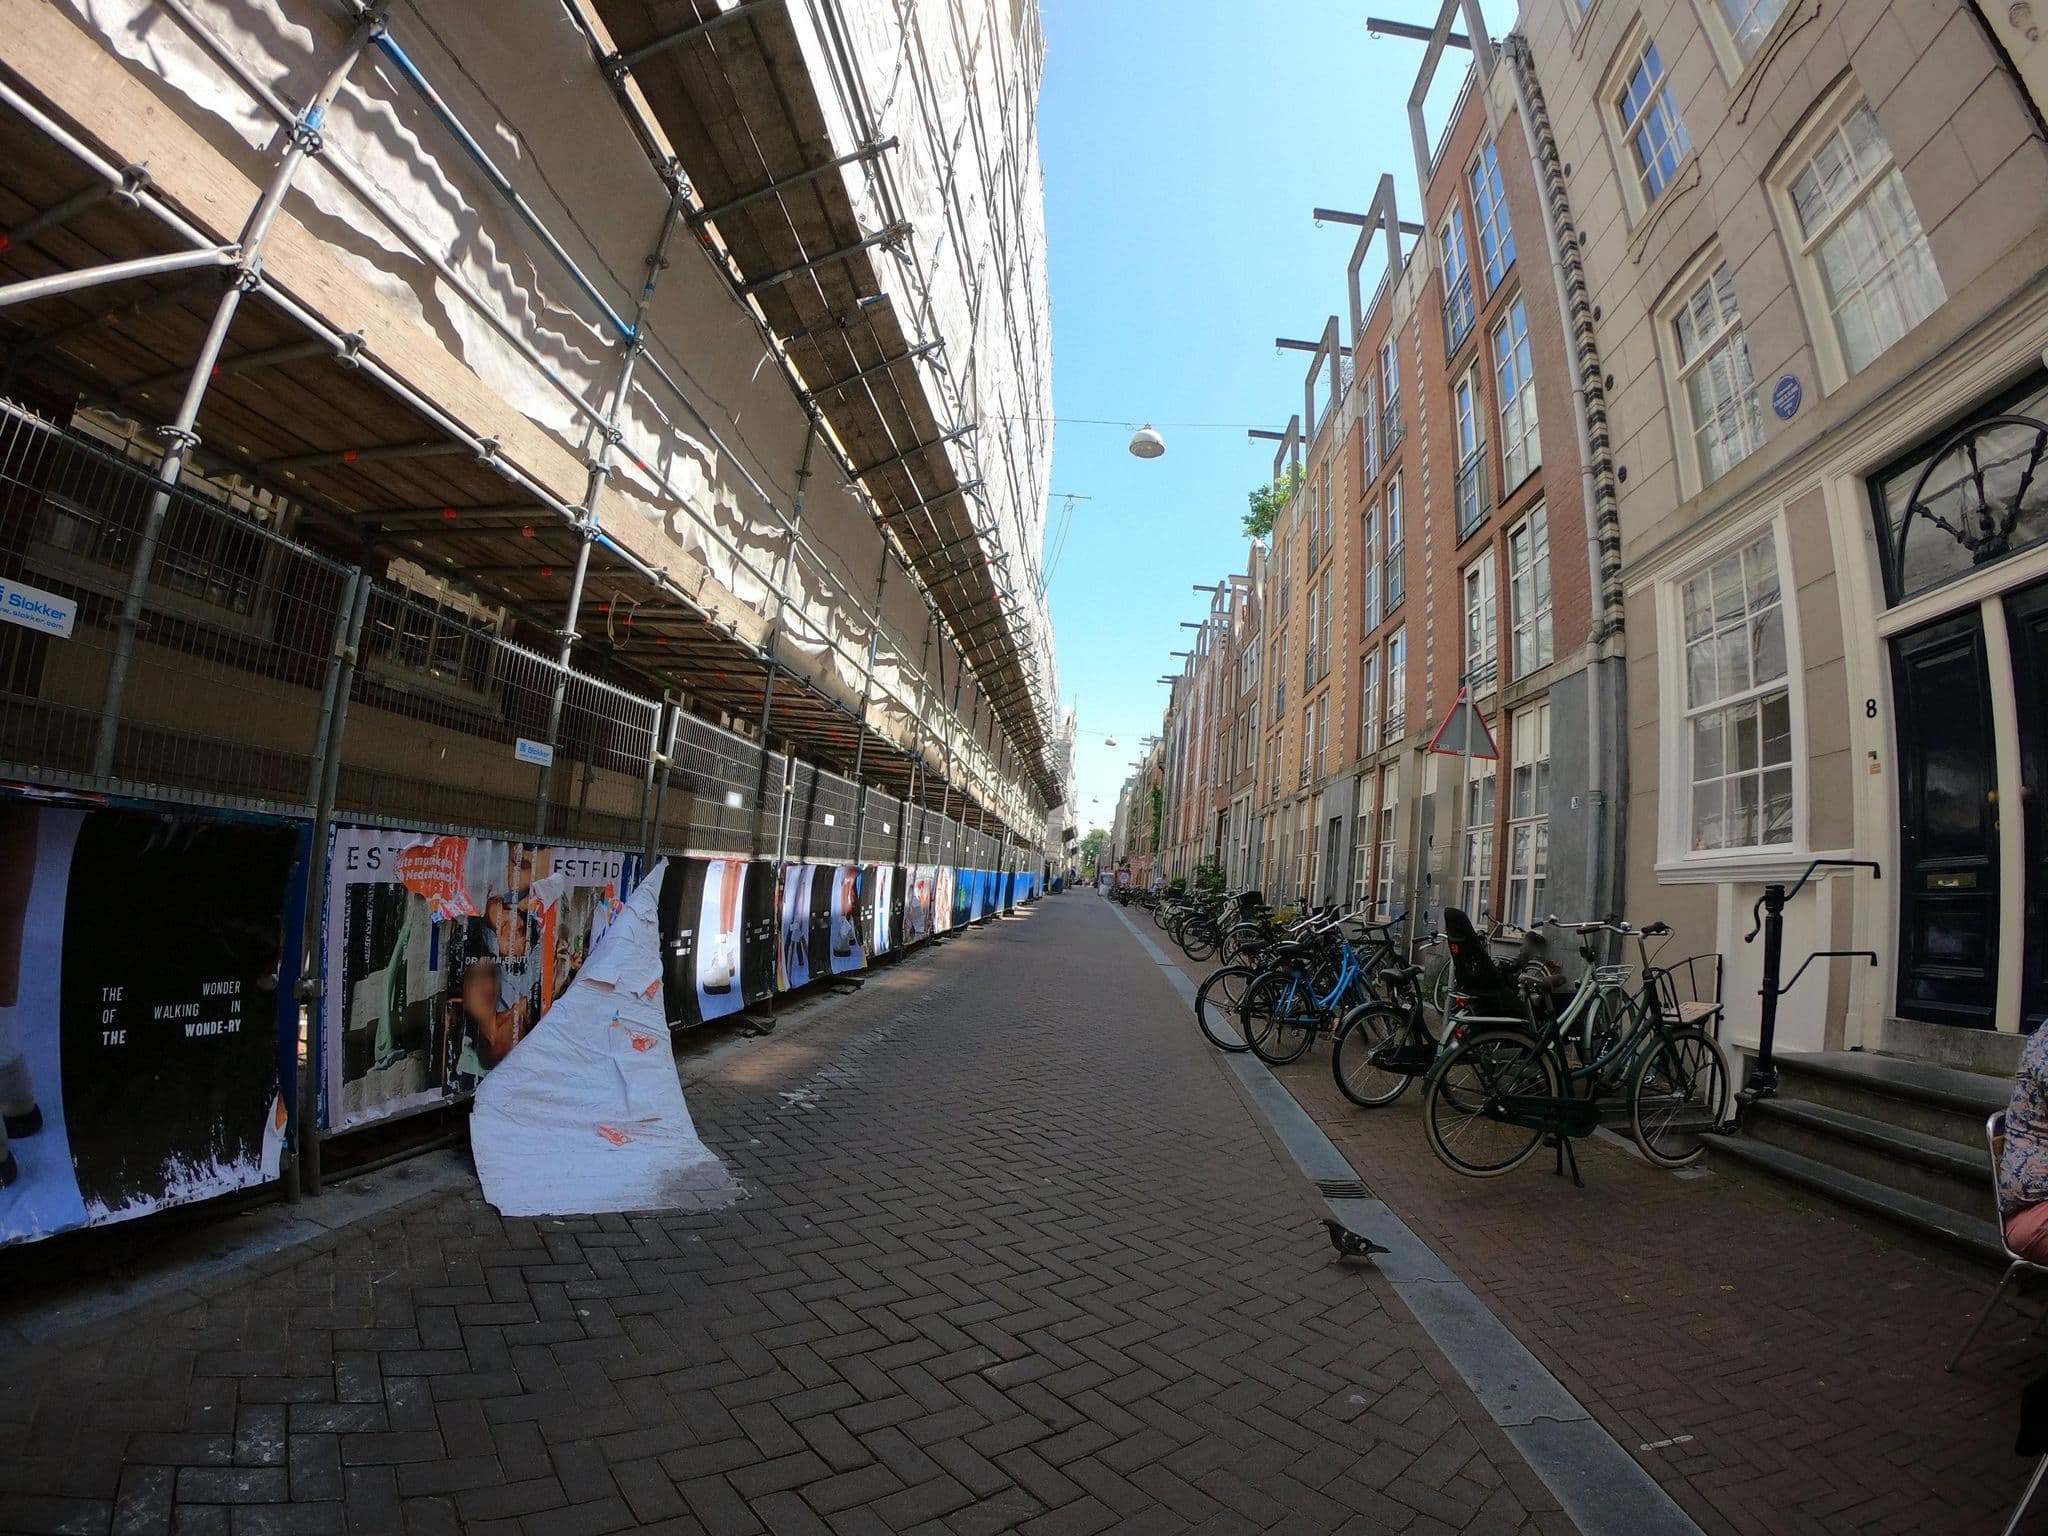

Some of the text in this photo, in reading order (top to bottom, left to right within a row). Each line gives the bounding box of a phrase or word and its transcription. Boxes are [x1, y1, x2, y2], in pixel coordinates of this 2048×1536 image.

[9, 593, 67, 620] Slokker
[1866, 698, 1877, 718] 8
[346, 846, 400, 870] ES
[102, 981, 240, 1002] THE WONDER
[102, 1000, 240, 1024] OF WALKING IN
[102, 1019, 241, 1046] THE WONDE-RY
